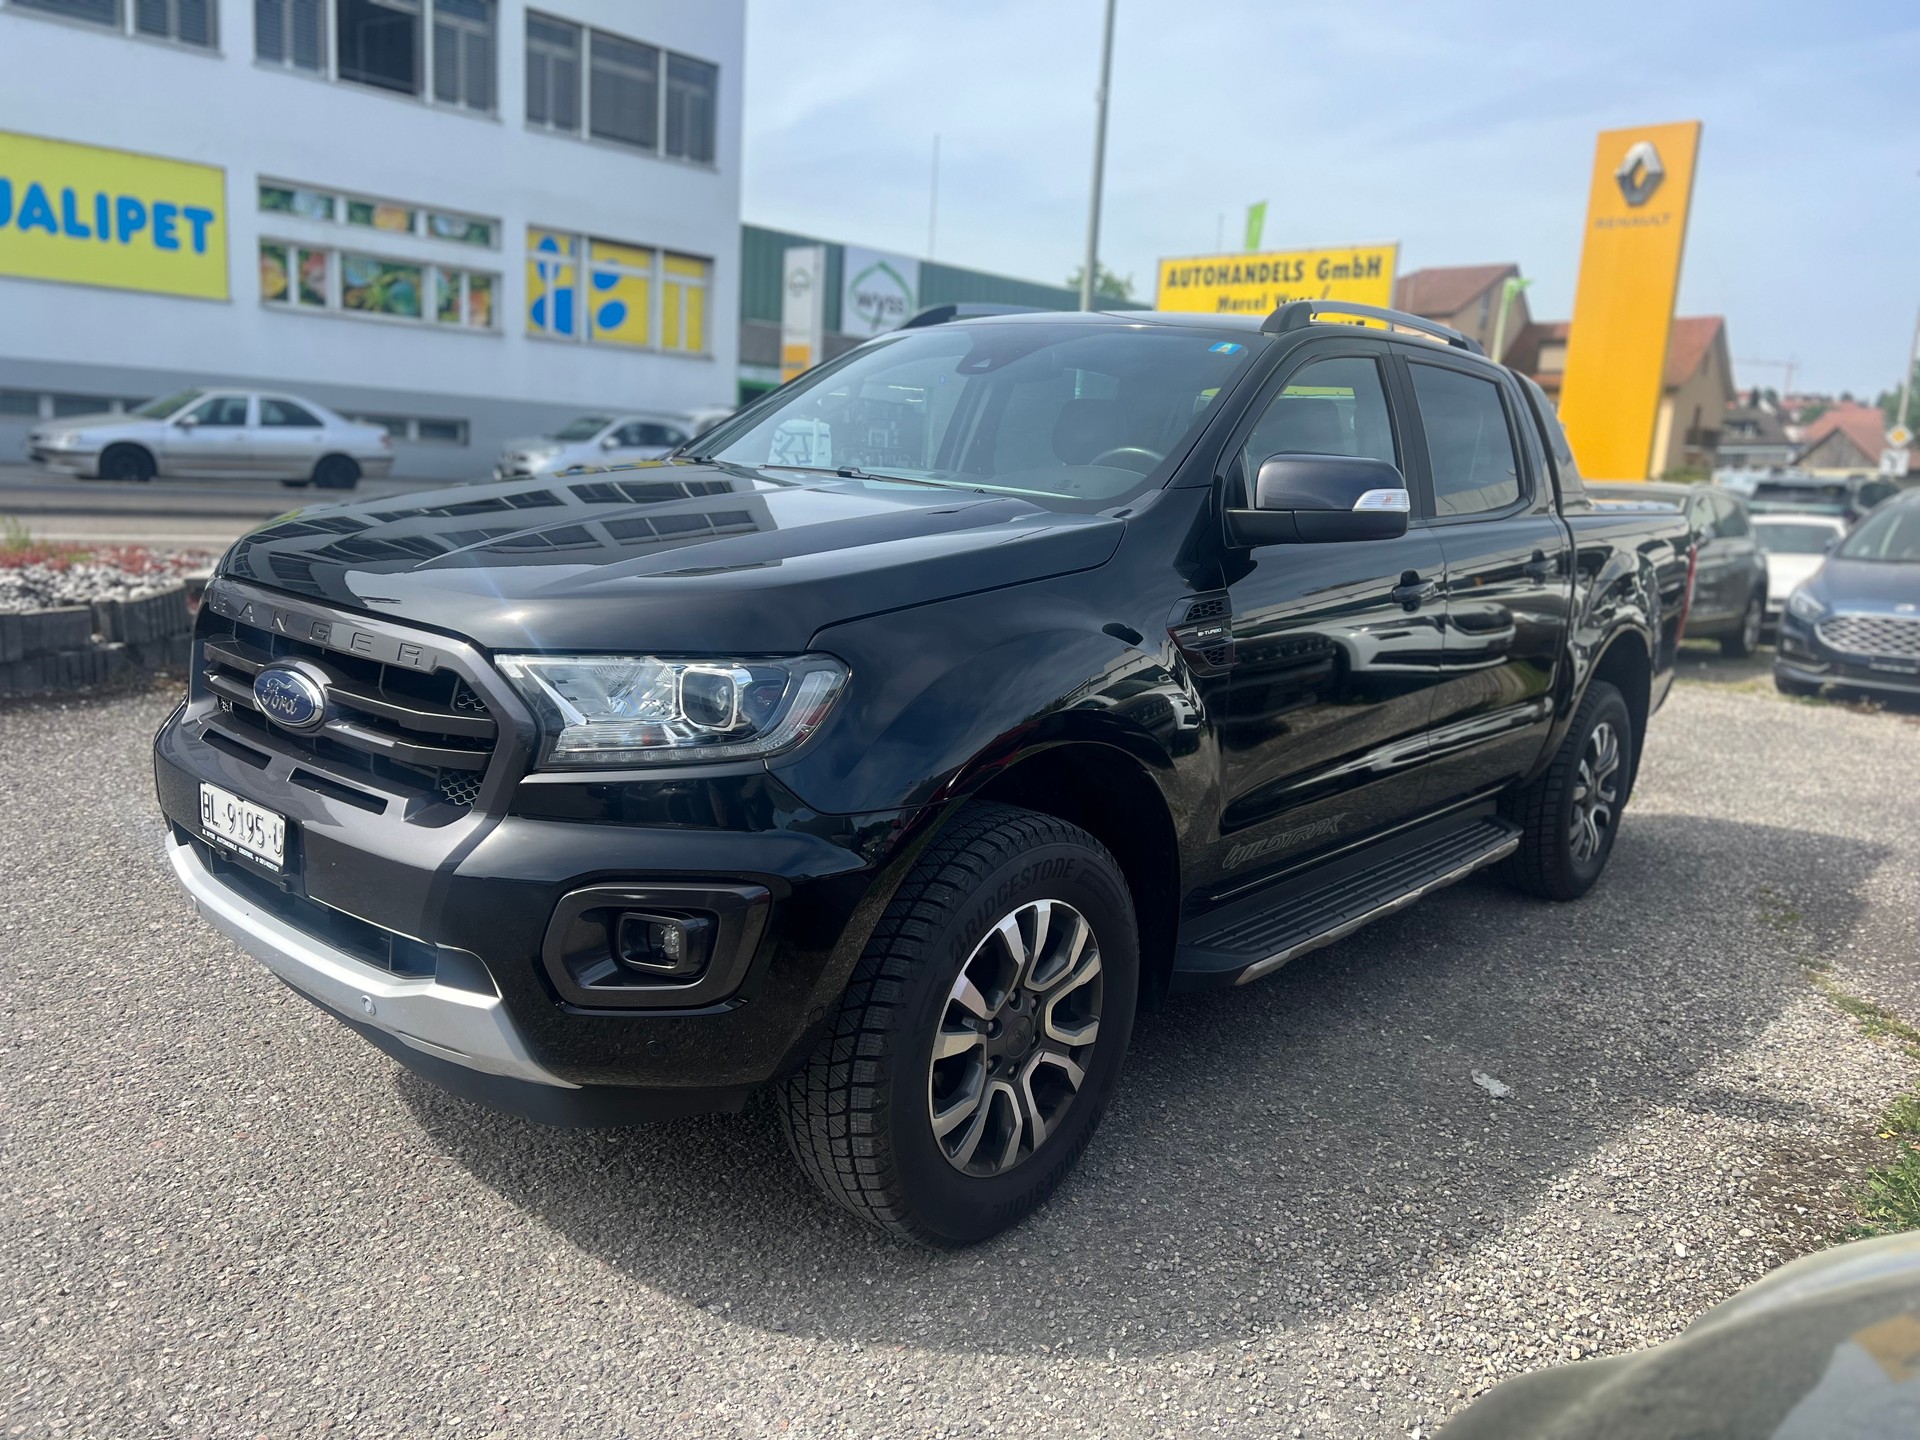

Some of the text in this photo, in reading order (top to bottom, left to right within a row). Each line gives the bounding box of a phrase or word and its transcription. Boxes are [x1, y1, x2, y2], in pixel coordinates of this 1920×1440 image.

[1167, 255, 1382, 288] AUTOHANDELS GmbH
[1216, 292, 1267, 313] Marcel
[213, 593, 425, 669] RANGER
[261, 677, 301, 716] Ford
[1222, 812, 1349, 870] WILDTRAK
[951, 857, 1076, 967] BRIDGESTONE
